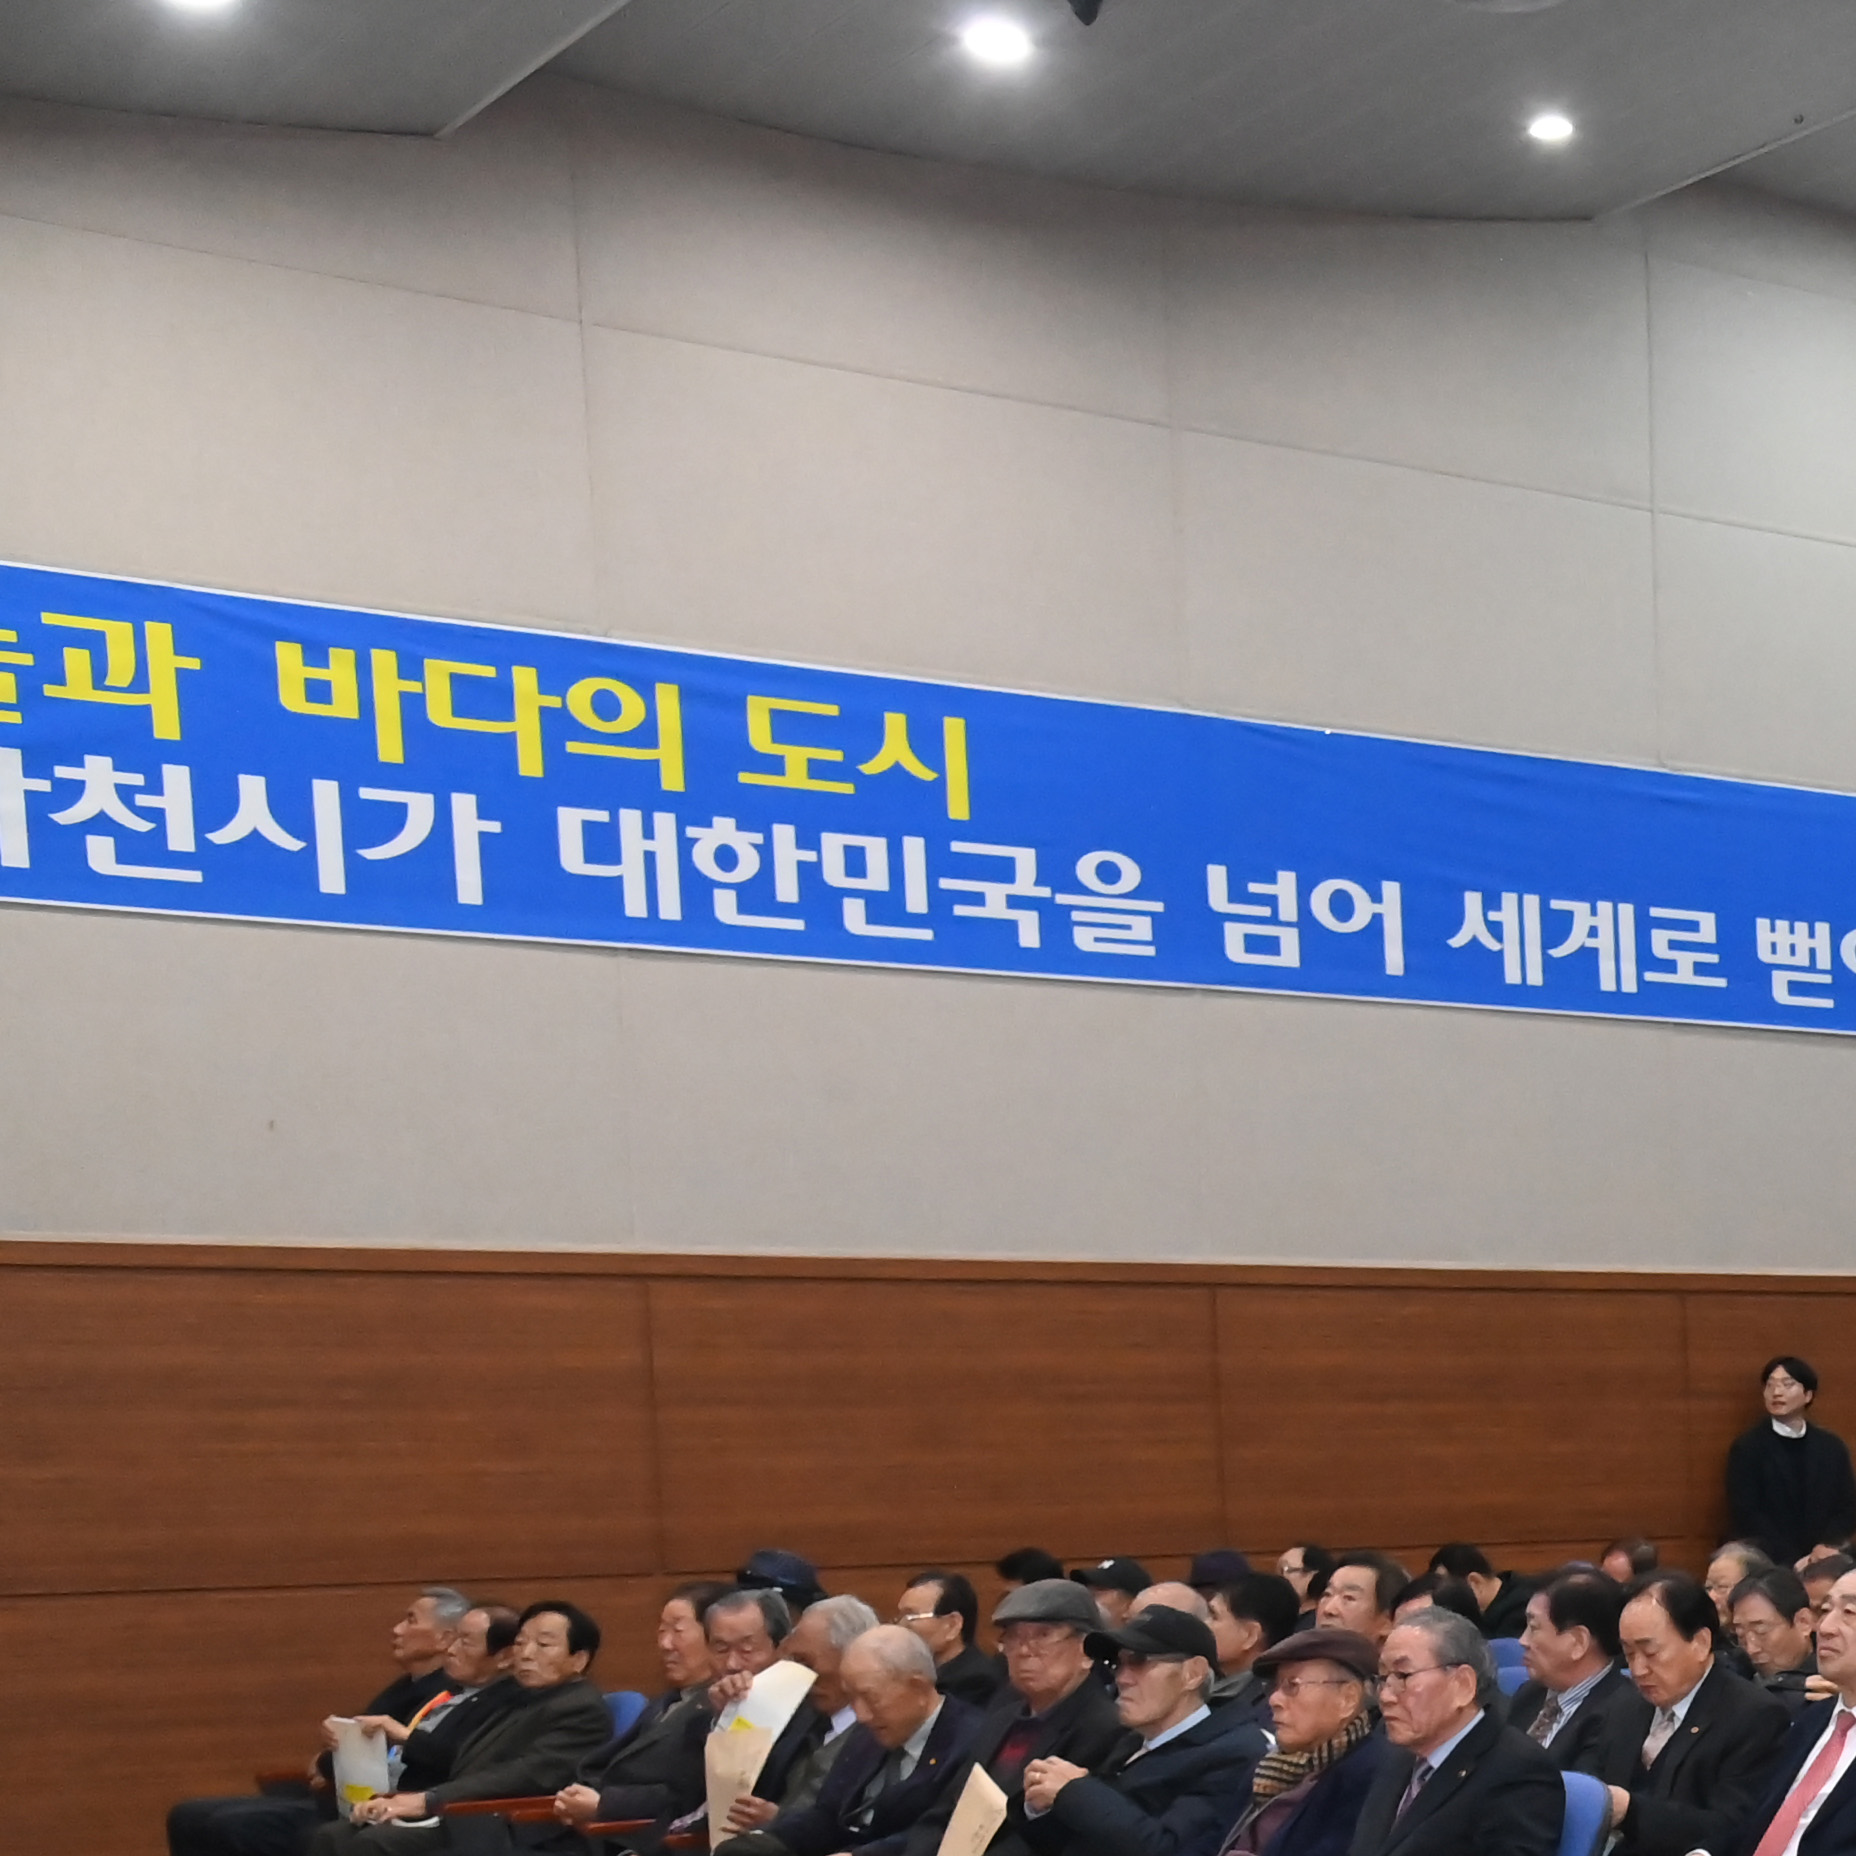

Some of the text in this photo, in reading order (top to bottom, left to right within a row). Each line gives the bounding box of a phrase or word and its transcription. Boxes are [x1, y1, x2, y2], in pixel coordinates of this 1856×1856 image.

[276, 641, 685, 791] 바다의
[738, 695, 970, 820] 도시
[557, 807, 1164, 956] 대한민국을
[1206, 865, 1405, 976] 넘어
[1448, 891, 1728, 993] 세계로
